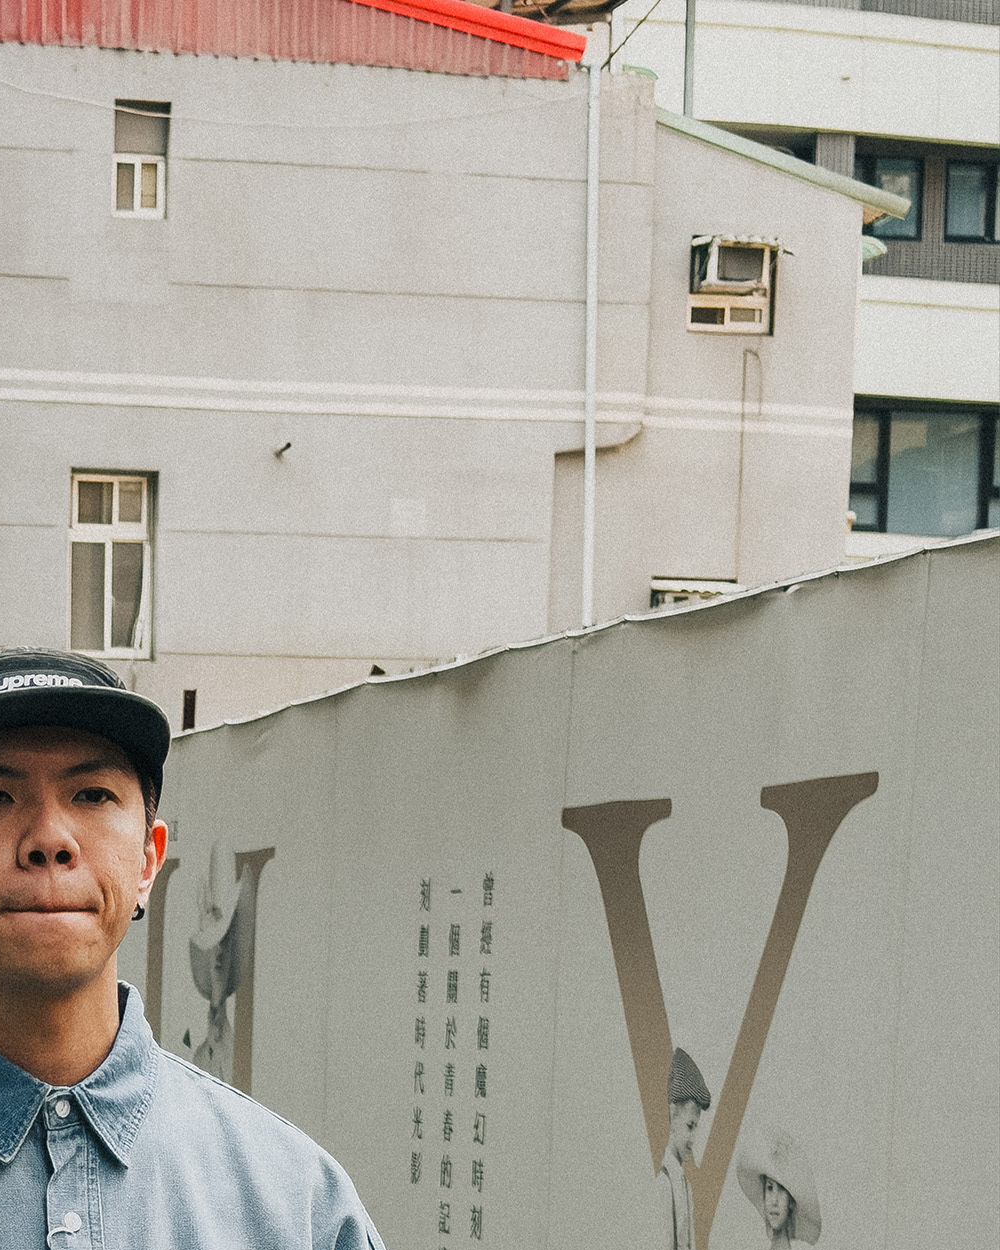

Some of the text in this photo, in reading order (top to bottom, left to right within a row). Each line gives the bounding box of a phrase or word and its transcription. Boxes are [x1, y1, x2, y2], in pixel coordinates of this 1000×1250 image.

[410, 877, 432, 1185] 刻劃著時代光影
[469, 871, 496, 1242] 曾經有個魔幻時刻
